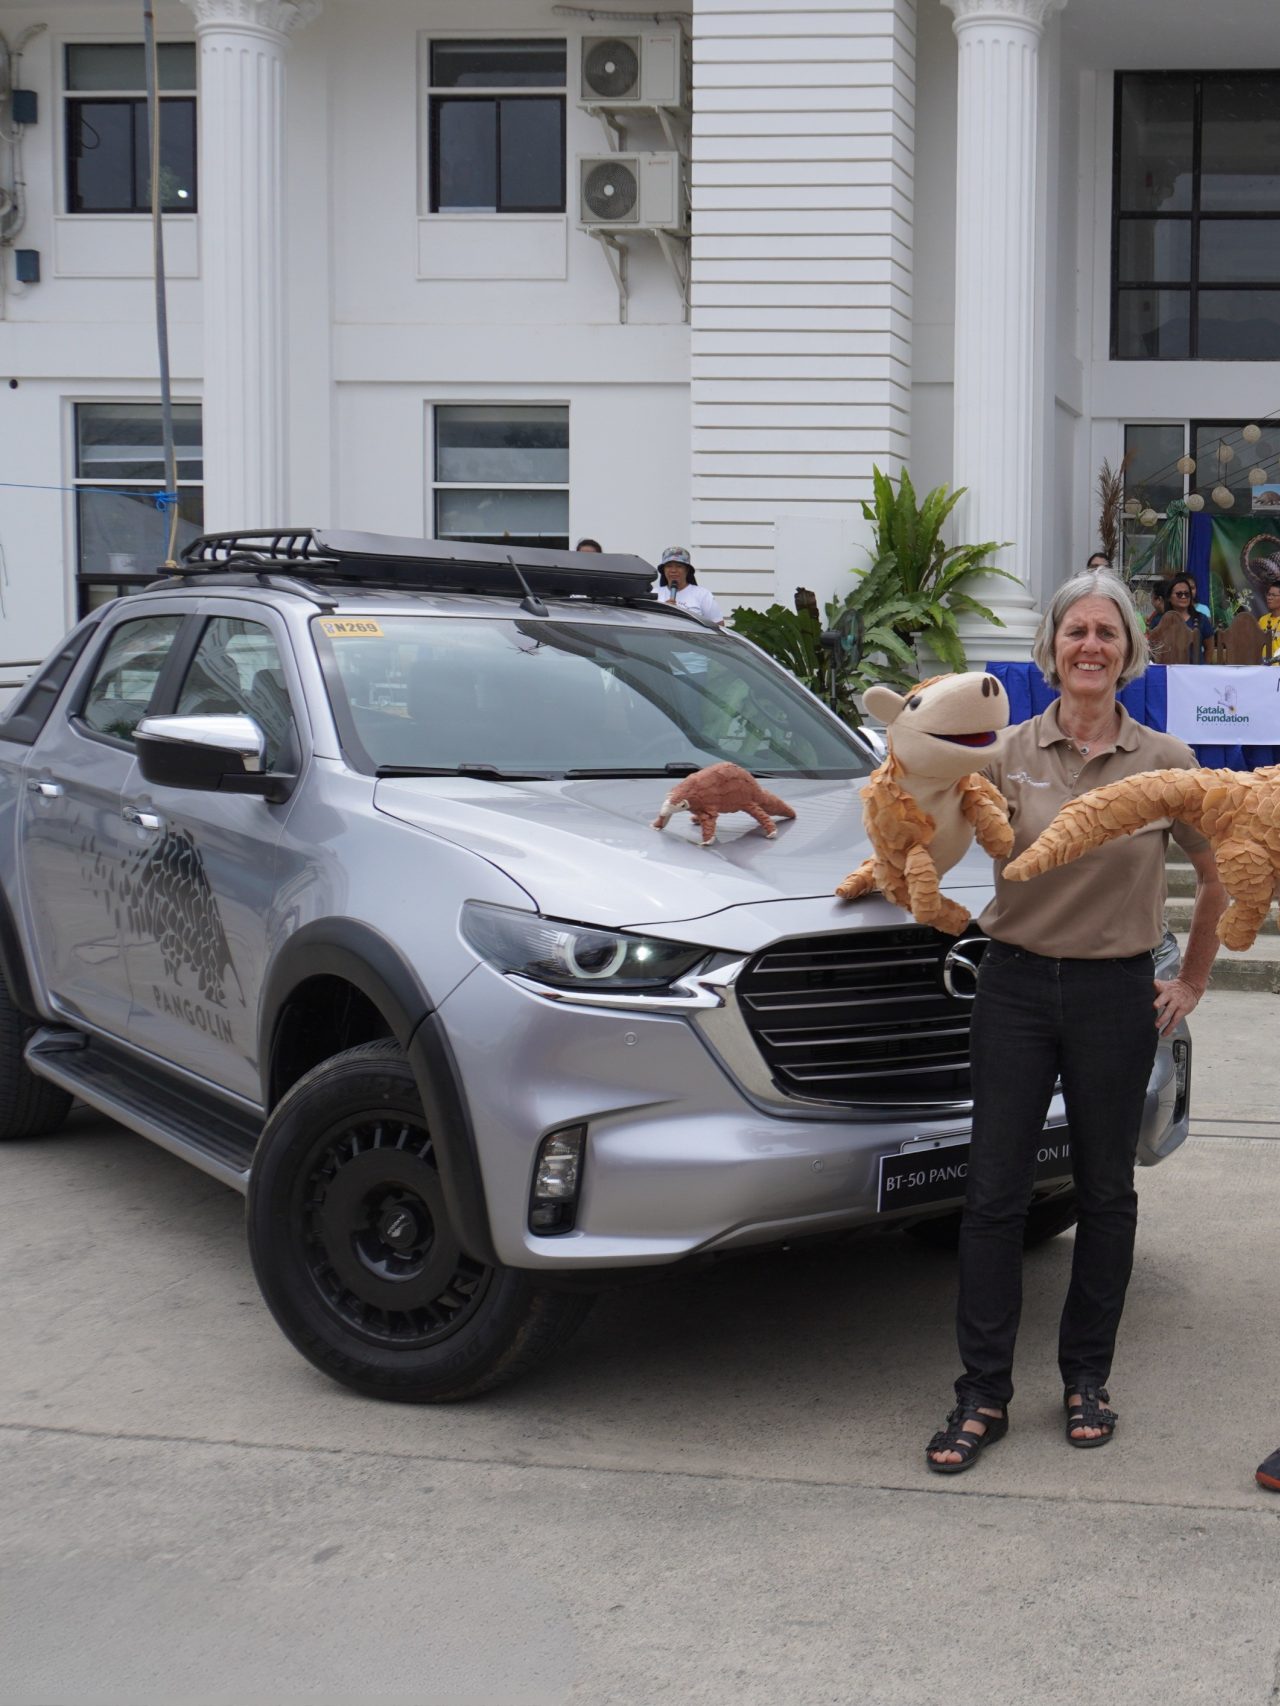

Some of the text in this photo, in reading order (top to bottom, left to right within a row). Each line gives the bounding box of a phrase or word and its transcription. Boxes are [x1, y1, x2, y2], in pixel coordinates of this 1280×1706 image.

[1196, 705, 1225, 715] Katala
[1196, 713, 1250, 723] Foundation
[152, 984, 235, 1045] PANGOLIN
[886, 1171, 926, 1192] BT-50
